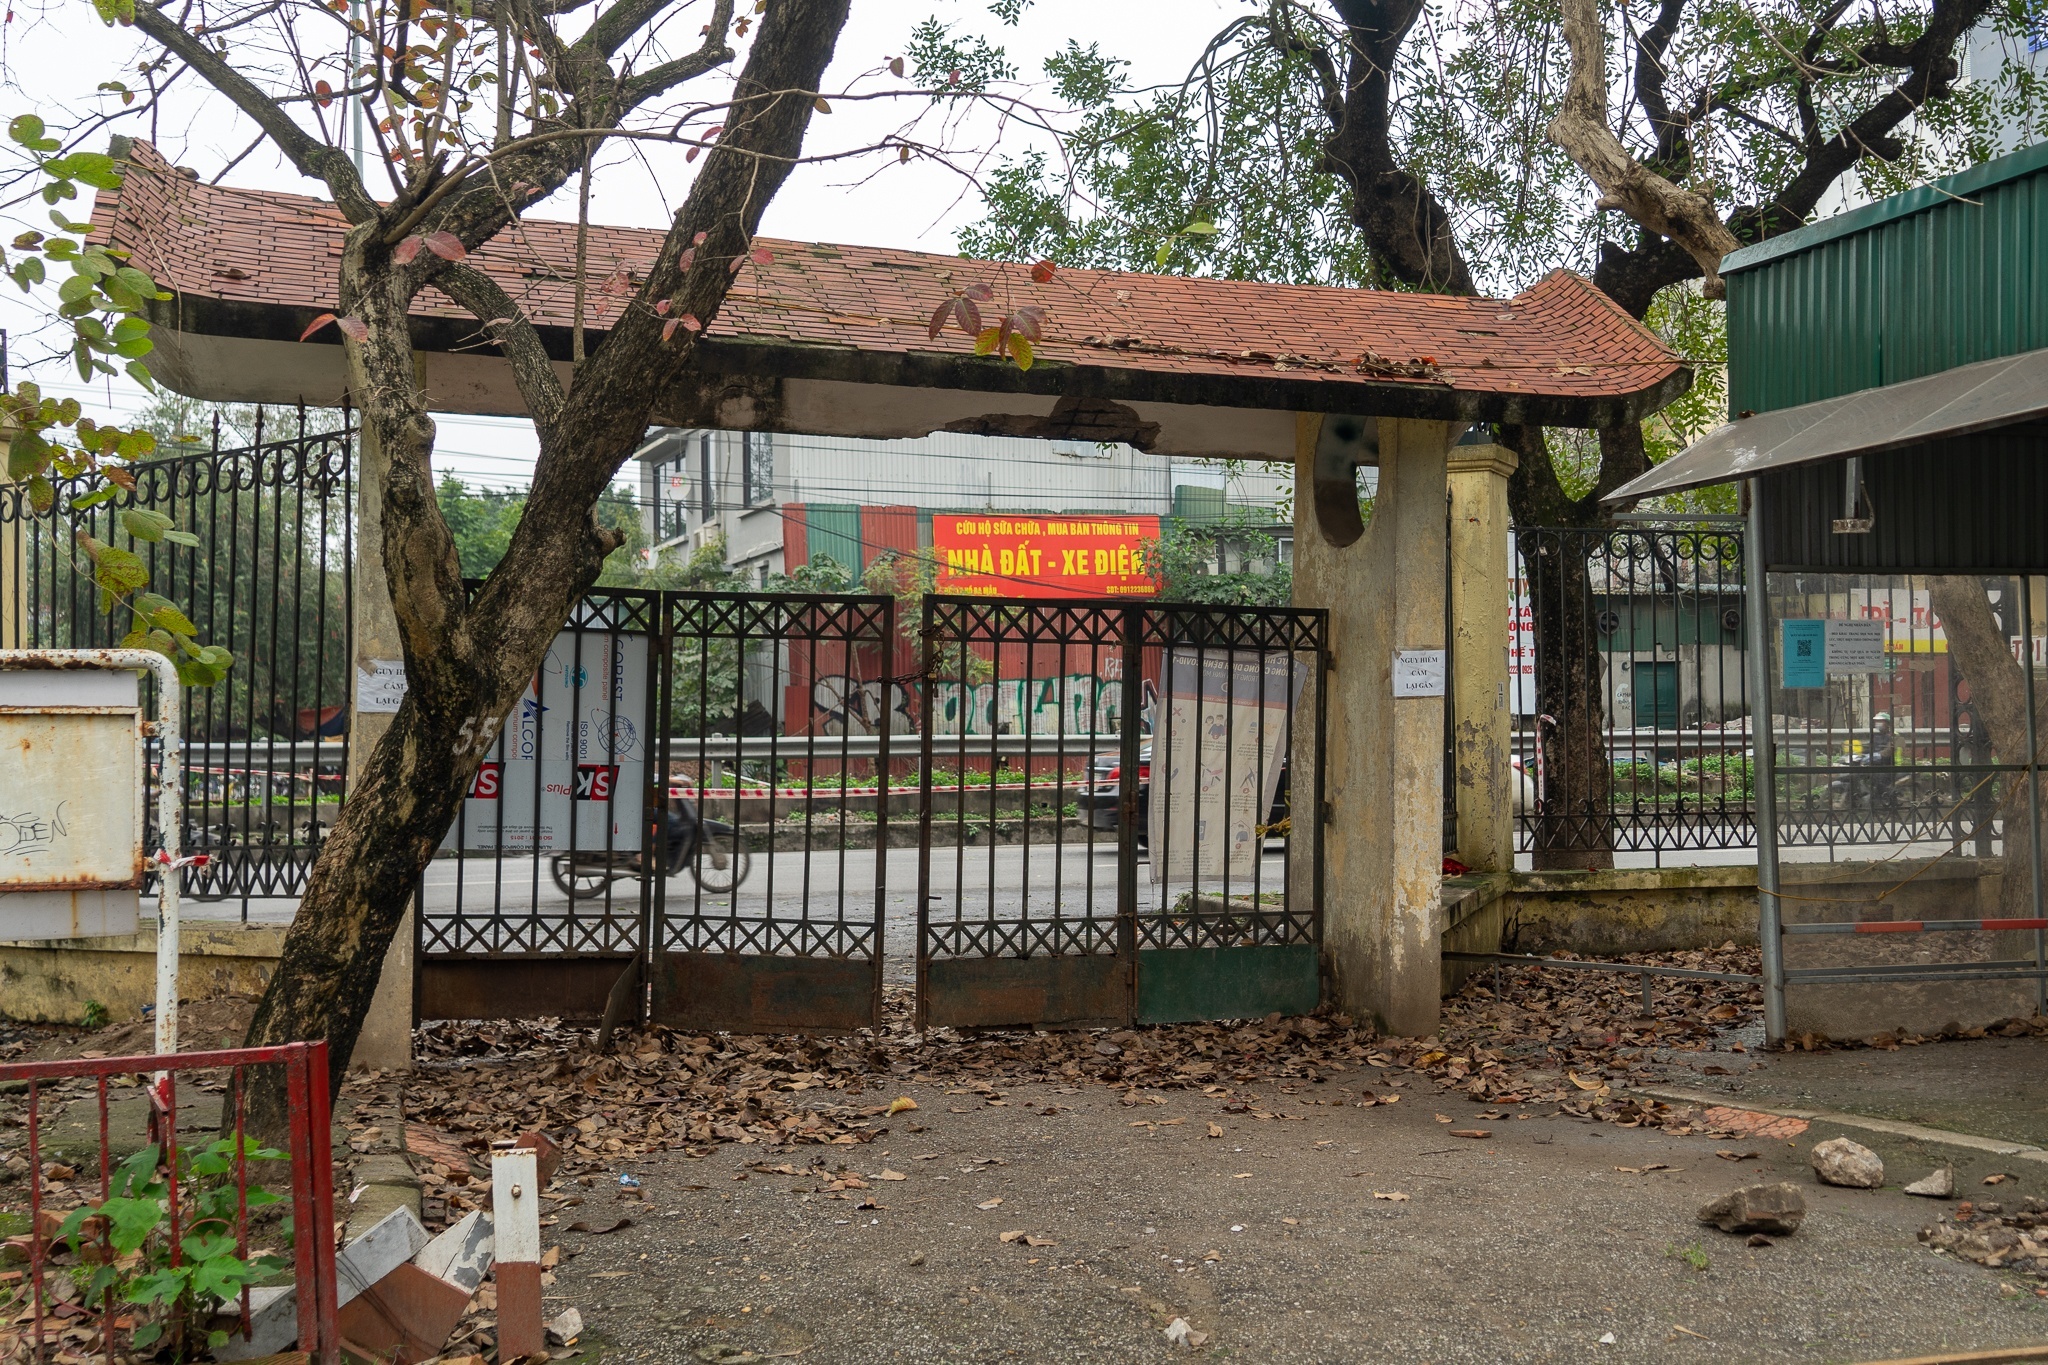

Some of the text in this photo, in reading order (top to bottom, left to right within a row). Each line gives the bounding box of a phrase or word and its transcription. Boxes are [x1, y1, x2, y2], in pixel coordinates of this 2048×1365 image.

[956, 519, 976, 535] CỨU
[978, 519, 991, 537] HỘ
[1015, 520, 1040, 535] CHỮA
[1048, 522, 1068, 535] MUA
[1070, 520, 1089, 535] BÁN
[1091, 520, 1122, 535] THÔNG
[1124, 523, 1139, 535] TIN
[947, 543, 995, 576] NHÀ
[1000, 540, 1042, 576] ĐẤT
[1062, 549, 1089, 576] XE
[1094, 543, 1146, 581] ĐIỆN
[373, 667, 394, 675] GUY
[1406, 682, 1417, 690] LẠI
[376, 697, 391, 706] LẠI
[580, 721, 588, 759] ISO 9001
[546, 783, 573, 796] Plus
